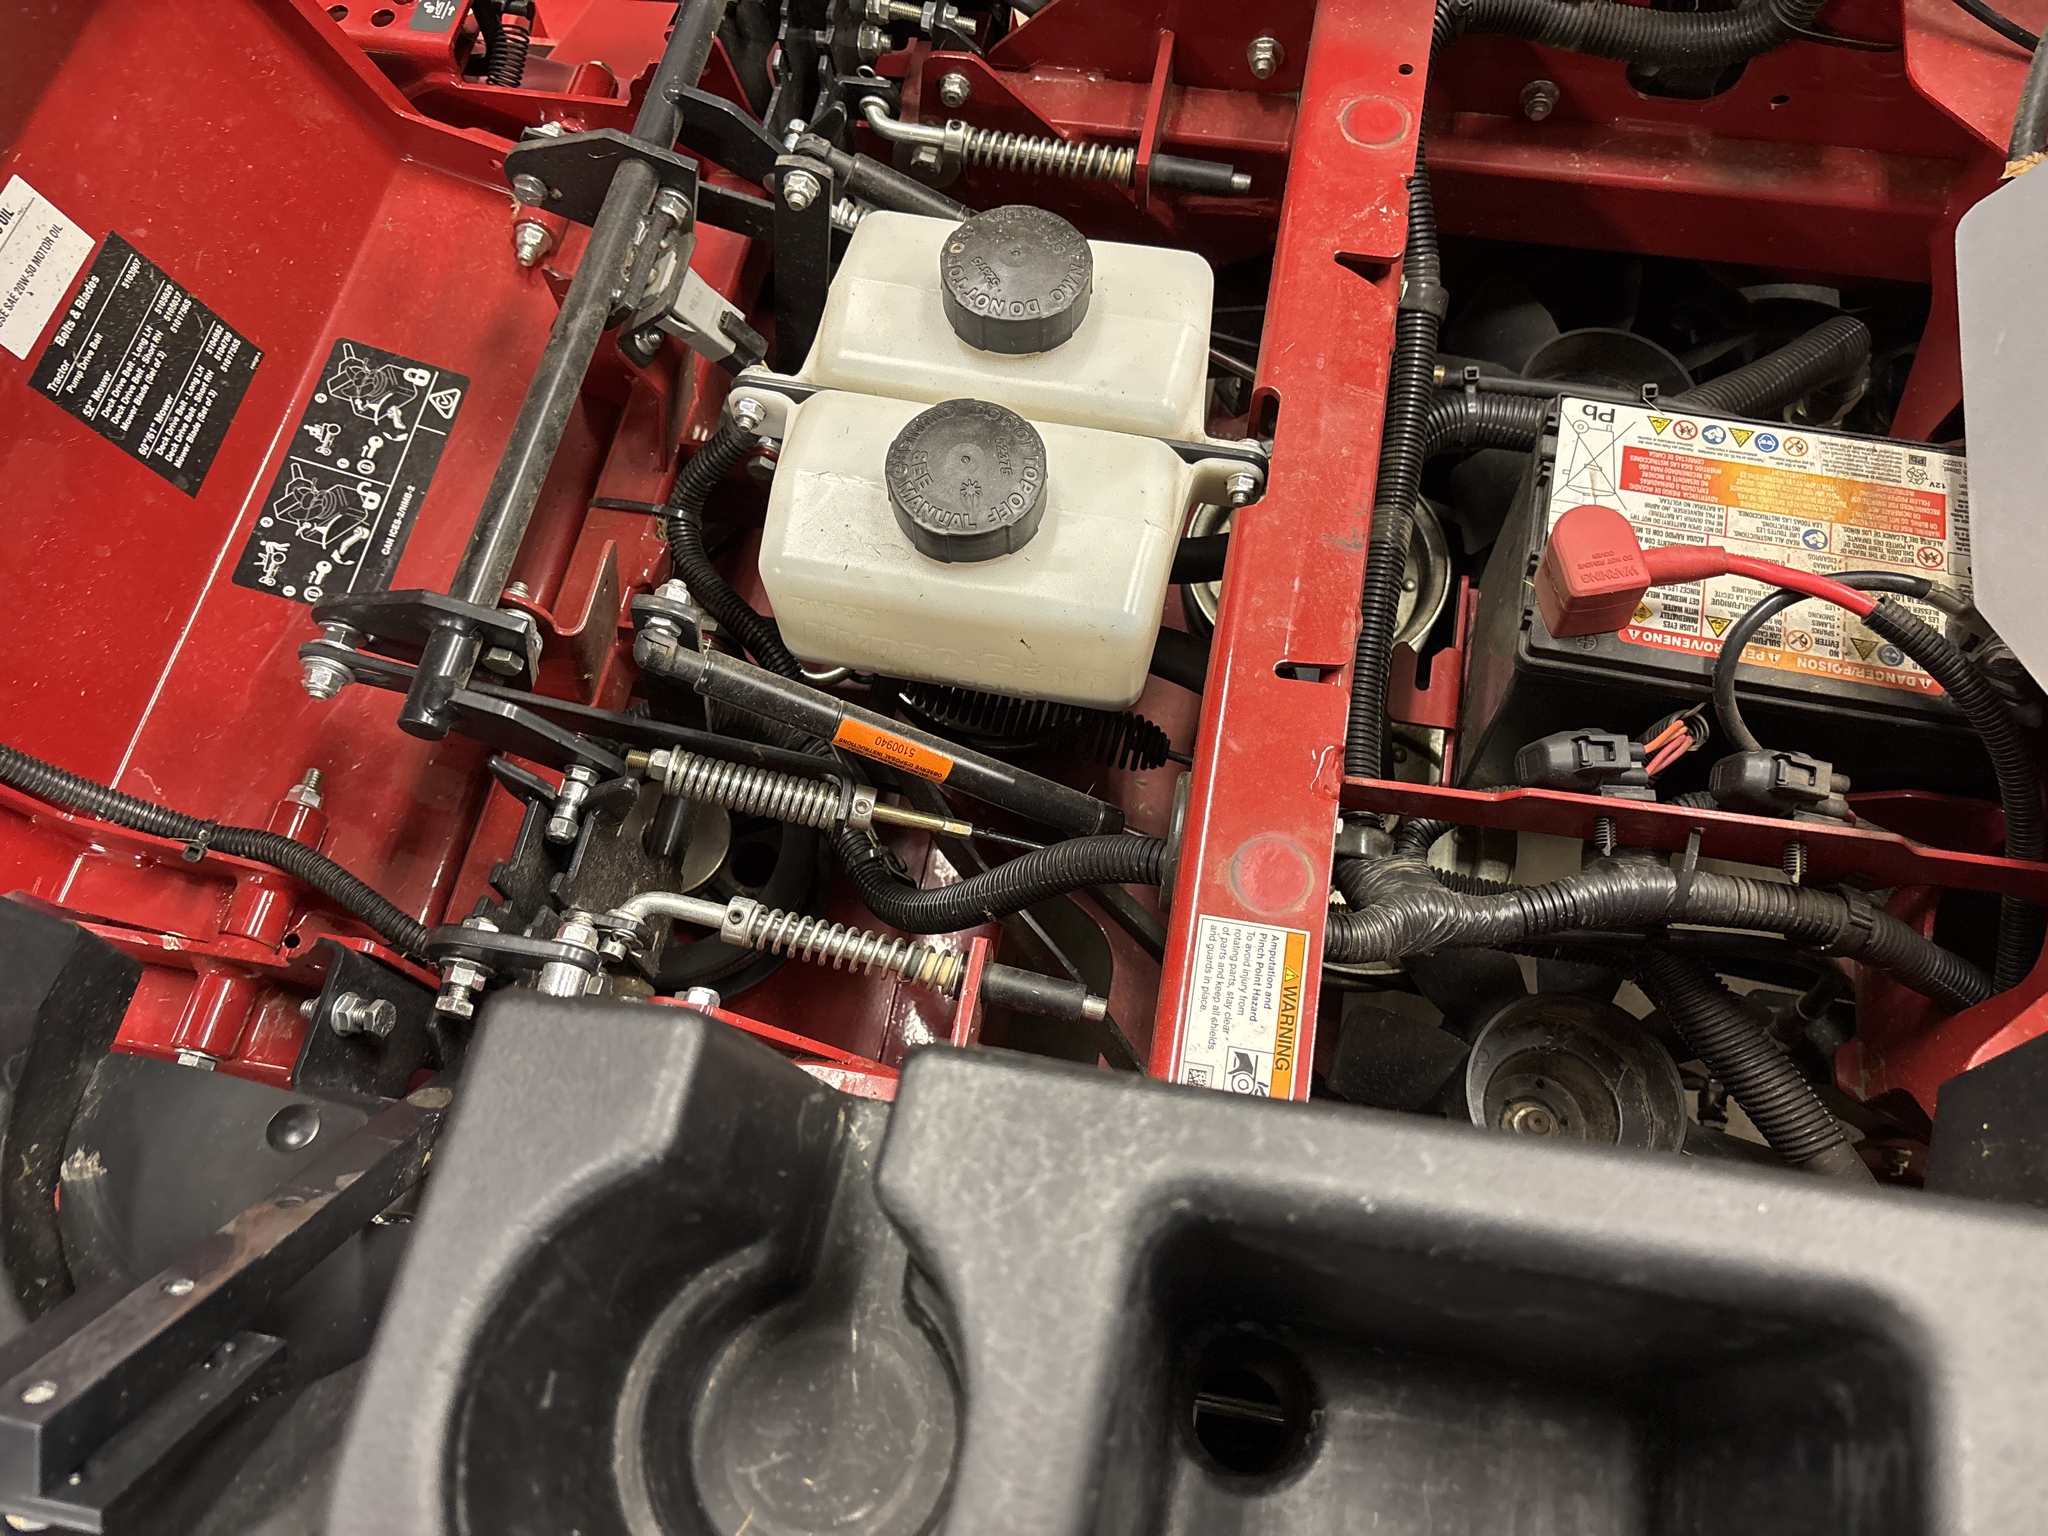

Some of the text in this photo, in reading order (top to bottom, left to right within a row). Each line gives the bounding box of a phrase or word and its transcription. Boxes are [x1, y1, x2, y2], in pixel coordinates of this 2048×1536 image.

[2, 292, 20, 311] SAE
[12, 263, 38, 295] 20W-50
[30, 235, 56, 267] MOTOR
[47, 222, 63, 238] OIL
[120, 257, 143, 289] 5103907
[54, 272, 100, 347] Belts & Blades
[153, 283, 174, 314] 5105029
[162, 290, 183, 322] 5105037
[963, 287, 1004, 315] NOT
[1008, 299, 1040, 315] DO
[169, 298, 192, 334] 5101756S
[46, 357, 71, 393] Tractor
[65, 331, 103, 395] Pump Drive Belt
[100, 324, 153, 418] Deck Drive Belt Long LH
[110, 329, 164, 425] Deck Drive Belt Short RH
[81, 369, 113, 418] 52" Mower
[119, 349, 168, 431] Mower Blade (Set of 3)
[153, 393, 175, 424] Mower
[154, 364, 205, 455] Deck Drive Belt Long LH
[163, 369, 215, 462] Deck Drive Belt Short RH
[1580, 404, 1615, 423] Pb
[172, 388, 219, 468] Mower Blade (Set of 3)
[911, 450, 933, 489] SEE
[969, 404, 1039, 522] DO NOT TOP OFF
[1909, 455, 1924, 465] Pb
[1929, 481, 1945, 489] 12V
[897, 480, 977, 528] MANUAL
[380, 484, 415, 556] CAN ICES-2/NMB-2
[1661, 519, 1686, 528] BATTERY!
[1687, 523, 1702, 531] OPEN
[1760, 520, 1800, 532] INSTRUCTIONS.
[1766, 528, 1787, 536] TOUTES
[1793, 518, 1810, 526] TODAS
[1732, 530, 1773, 541] INSTRUCTIONS.
[1785, 538, 1800, 546] READ
[1867, 544, 1883, 552] TENIR
[1576, 559, 1605, 569] REMOVE
[1606, 556, 1621, 564] NOT
[1848, 548, 1866, 556] REACH
[1579, 565, 1639, 583] WARNING
[1661, 592, 1687, 603] MEDICAL
[1661, 603, 1699, 615] WITH WATER.
[1688, 597, 1699, 605] GET
[1659, 611, 1698, 623] IMMEDIATELY
[1662, 620, 1697, 632] FLUSH EYES
[1810, 619, 1835, 628] FLAMES
[1811, 627, 1834, 636] SPARKS
[1814, 637, 1839, 649] ÉVITER
[1828, 649, 1839, 657] NO
[1796, 657, 1917, 687] DANGER/POISON
[837, 736, 942, 778] OBSERVE DISPOSAL INSTRUCTIONS
[874, 735, 916, 758] 5100940
[1197, 924, 1218, 1012] and guards in place.
[1221, 928, 1242, 1034] rotating parts, stay clear
[1236, 930, 1255, 1016] To avoid injury from
[1248, 932, 1268, 1022] Pinch Point Hazard
[1262, 934, 1280, 1009] Amputation and
[1206, 926, 1230, 1050] of parts and keep all shields
[1272, 984, 1300, 1071] WARNING
